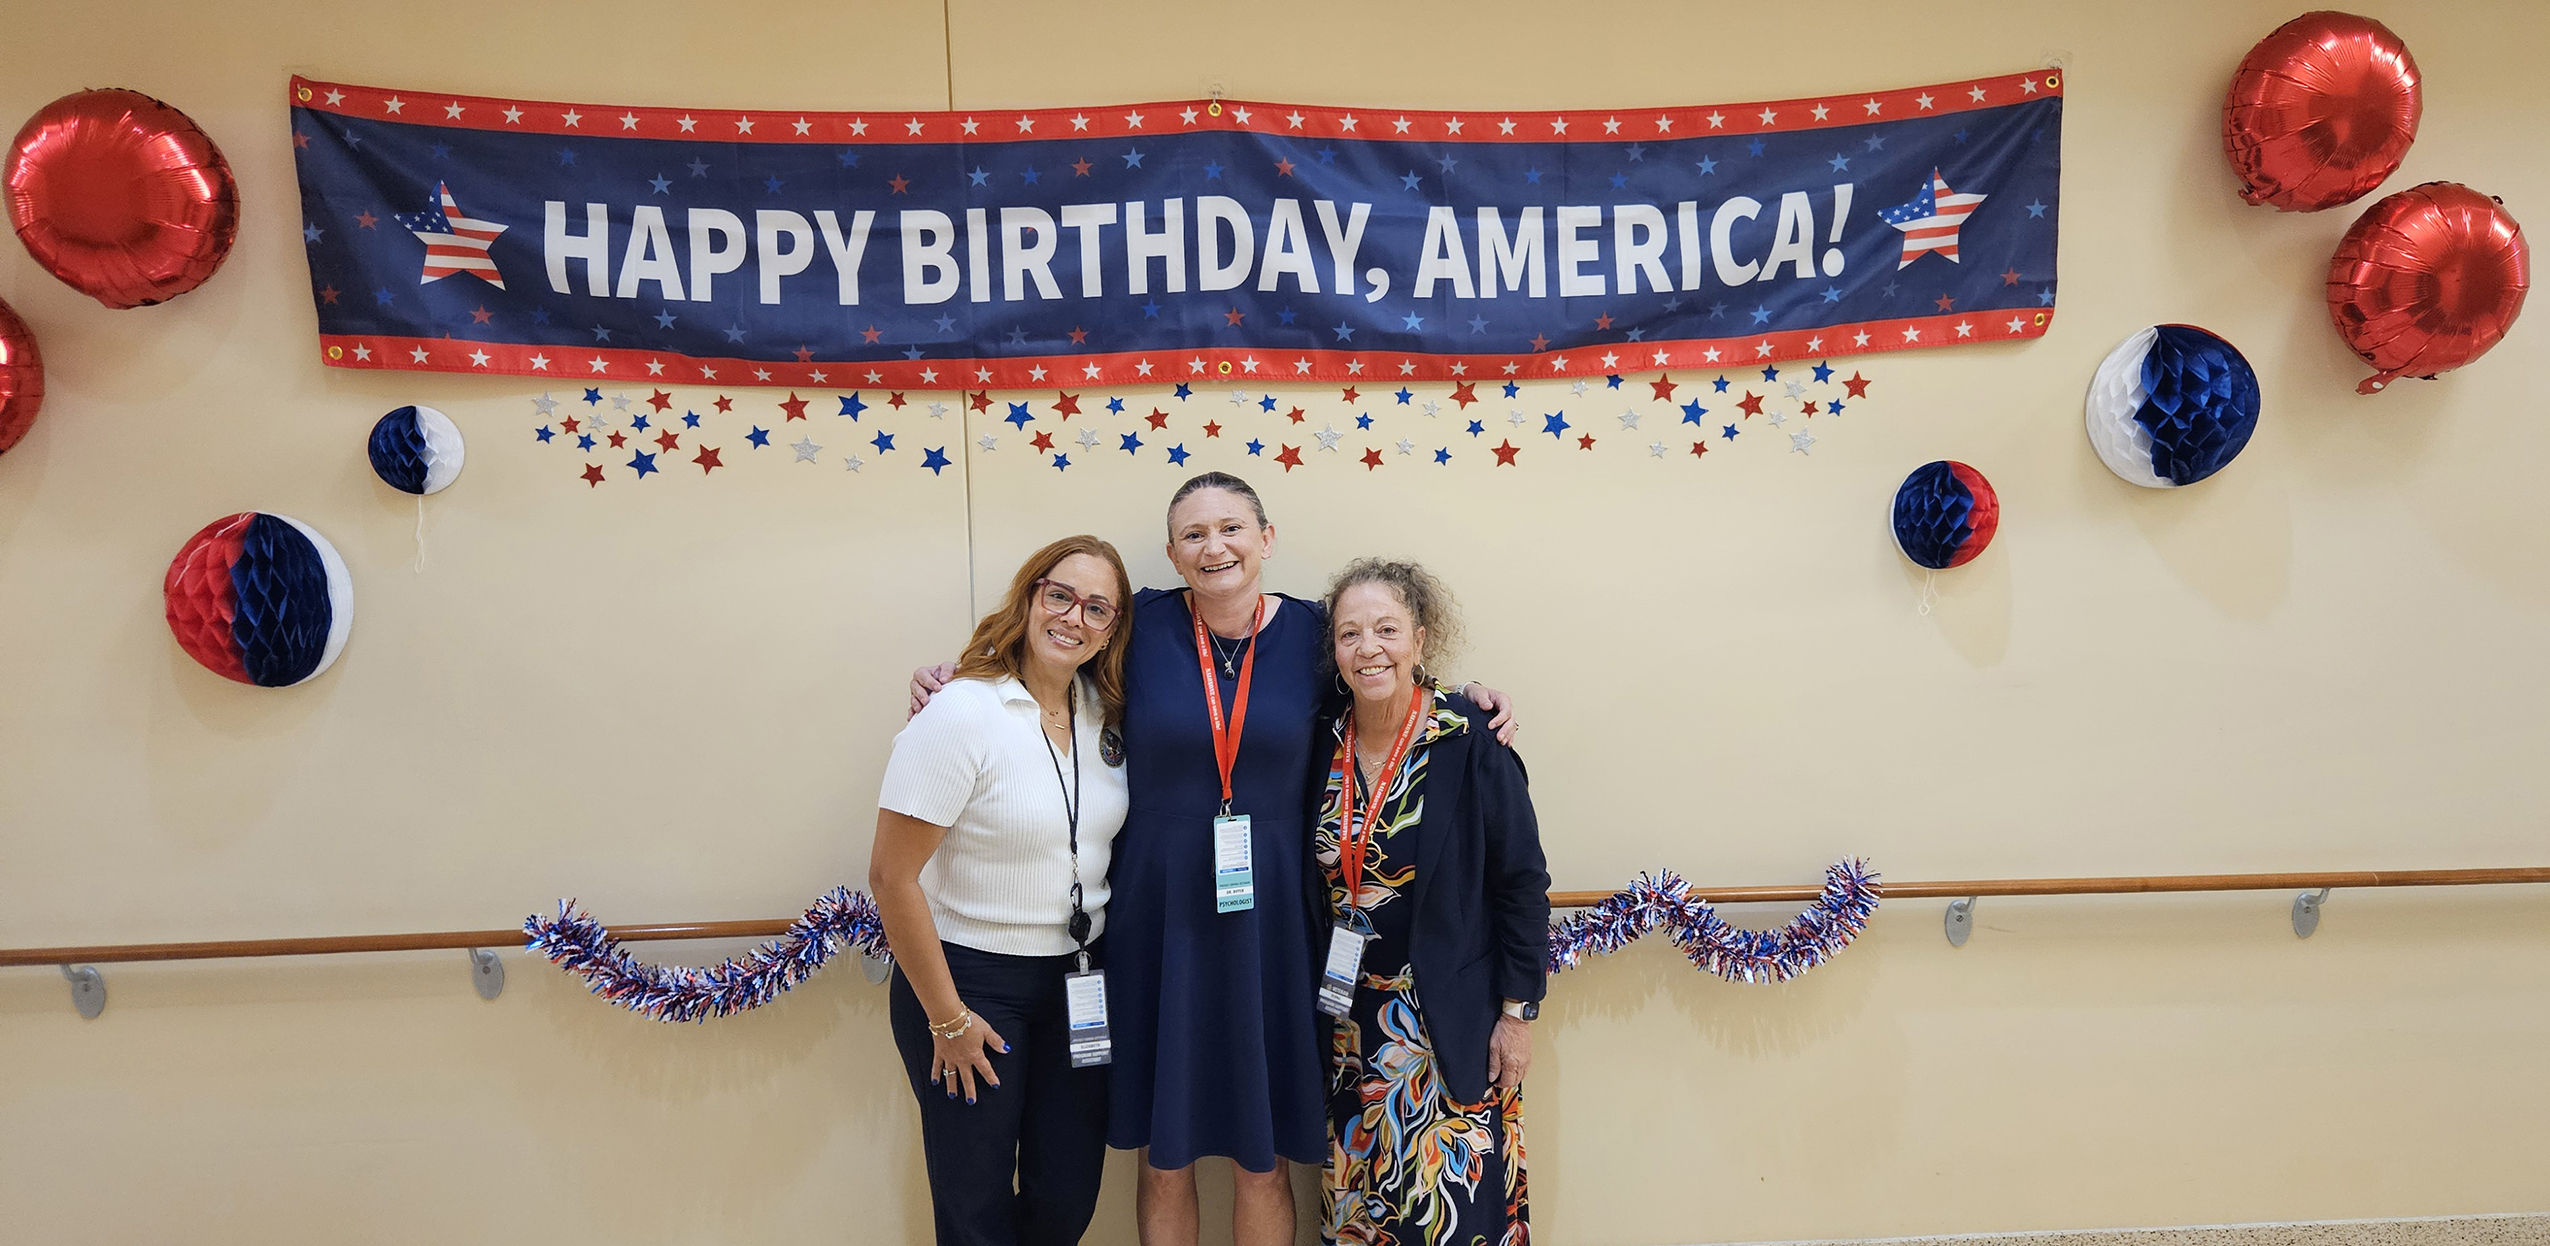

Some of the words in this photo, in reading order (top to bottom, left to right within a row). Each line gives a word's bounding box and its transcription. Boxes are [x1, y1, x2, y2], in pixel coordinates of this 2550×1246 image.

[543, 200, 877, 306] HAPPY
[899, 194, 1392, 307] BIRTHDAY,
[1413, 183, 1855, 300] AMERICA!
[1403, 709, 1417, 739] NALOXONE
[1393, 746, 1401, 758] save
[1387, 761, 1395, 771] life!
[1372, 780, 1386, 810] NALOXONE
[1219, 898, 1252, 907] PSYCHOLOGIST
